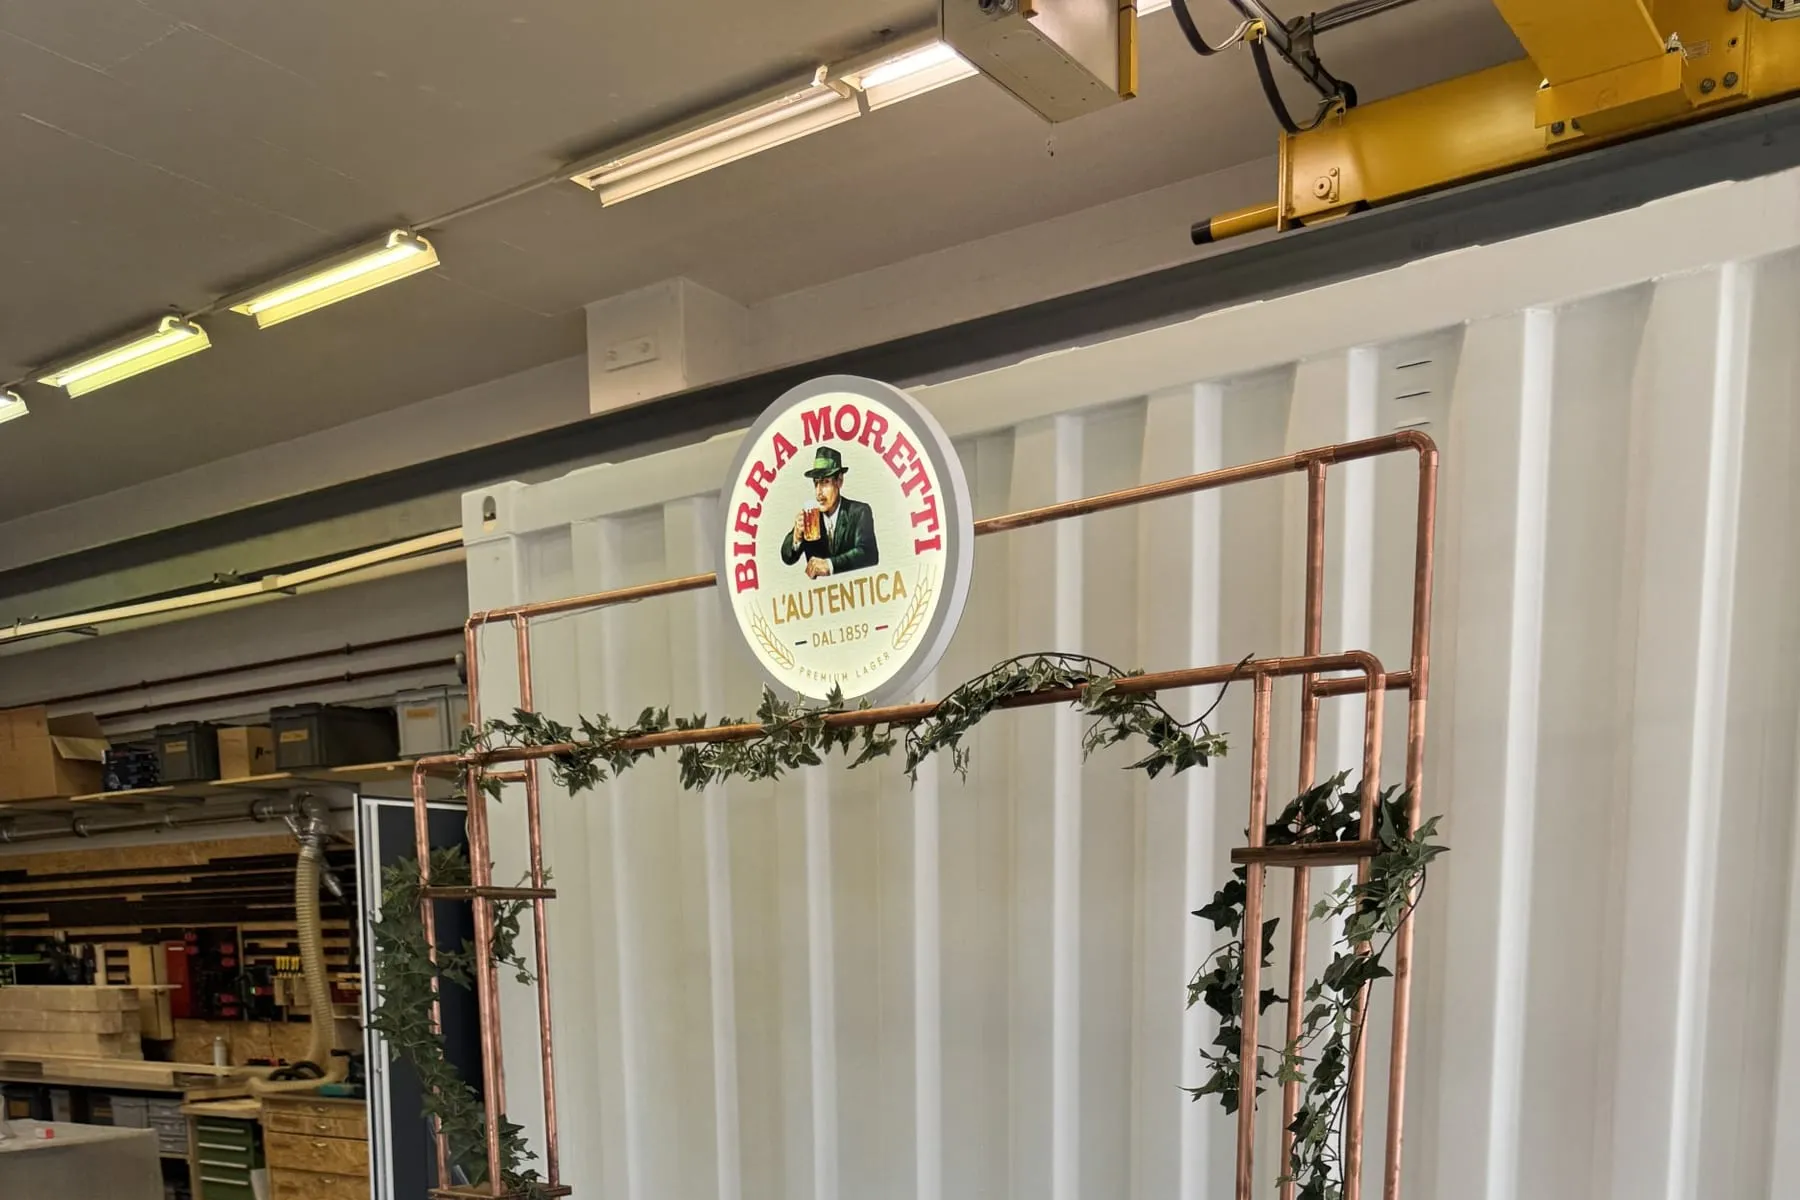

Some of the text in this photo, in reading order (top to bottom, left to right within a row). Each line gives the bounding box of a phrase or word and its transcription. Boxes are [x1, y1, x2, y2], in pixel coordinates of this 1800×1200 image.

[734, 404, 942, 594] BIRRA MORETTI
[772, 570, 907, 625] L'AUTENTICA
[812, 623, 869, 648] DAL 1859
[799, 651, 890, 682] PREMIUM LAGER
